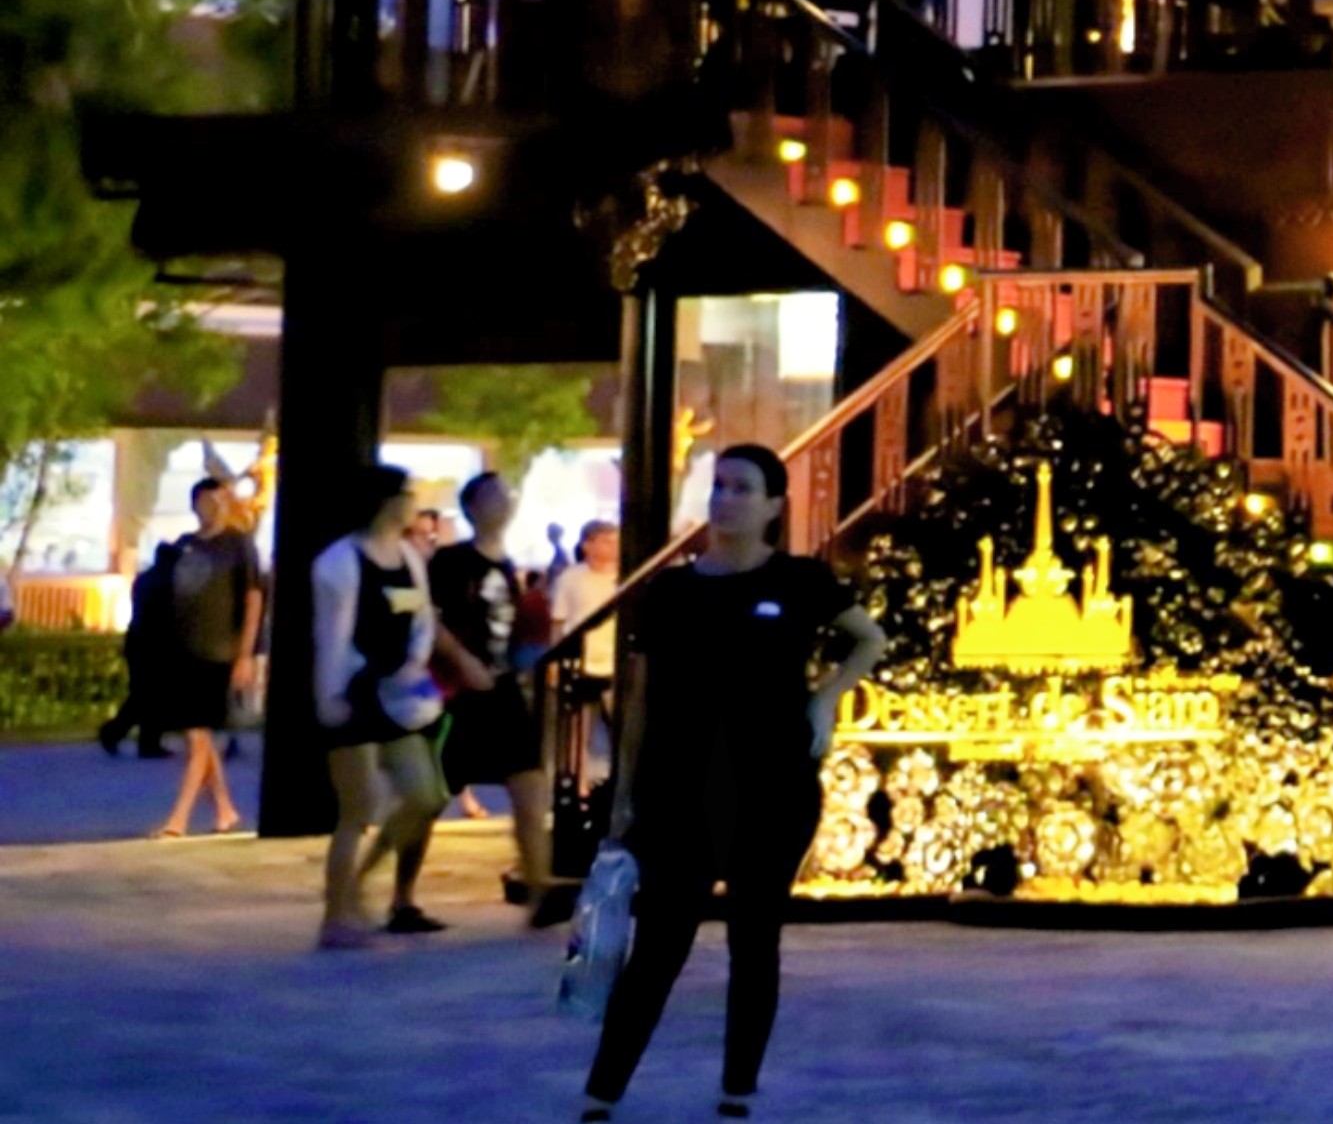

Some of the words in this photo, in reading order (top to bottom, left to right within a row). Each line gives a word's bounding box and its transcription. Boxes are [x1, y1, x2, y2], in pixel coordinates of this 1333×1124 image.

[838, 678, 1016, 731] Dessert
[1030, 676, 1087, 731] de
[1102, 675, 1219, 732] Siam
